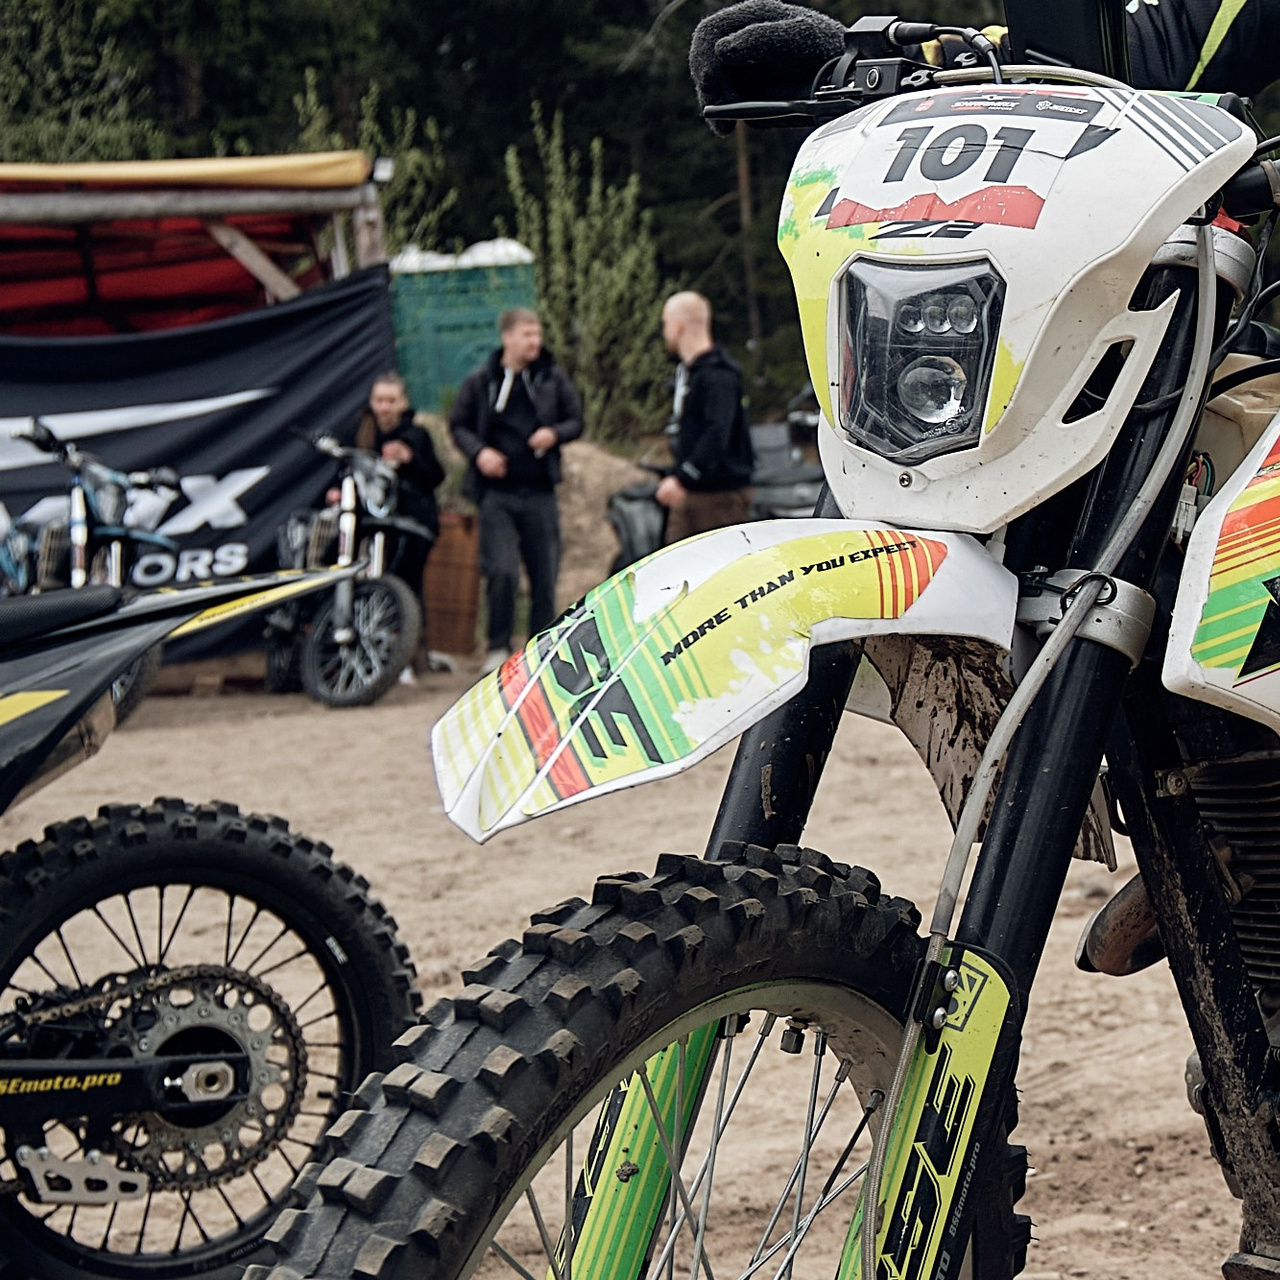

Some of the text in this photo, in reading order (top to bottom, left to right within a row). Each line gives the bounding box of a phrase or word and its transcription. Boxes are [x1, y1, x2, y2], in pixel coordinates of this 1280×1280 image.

[882, 123, 1036, 184] 101
[660, 540, 918, 666] MORE THAN YOU EXPECT
[949, 1140, 982, 1239] BSEmoto.pro
